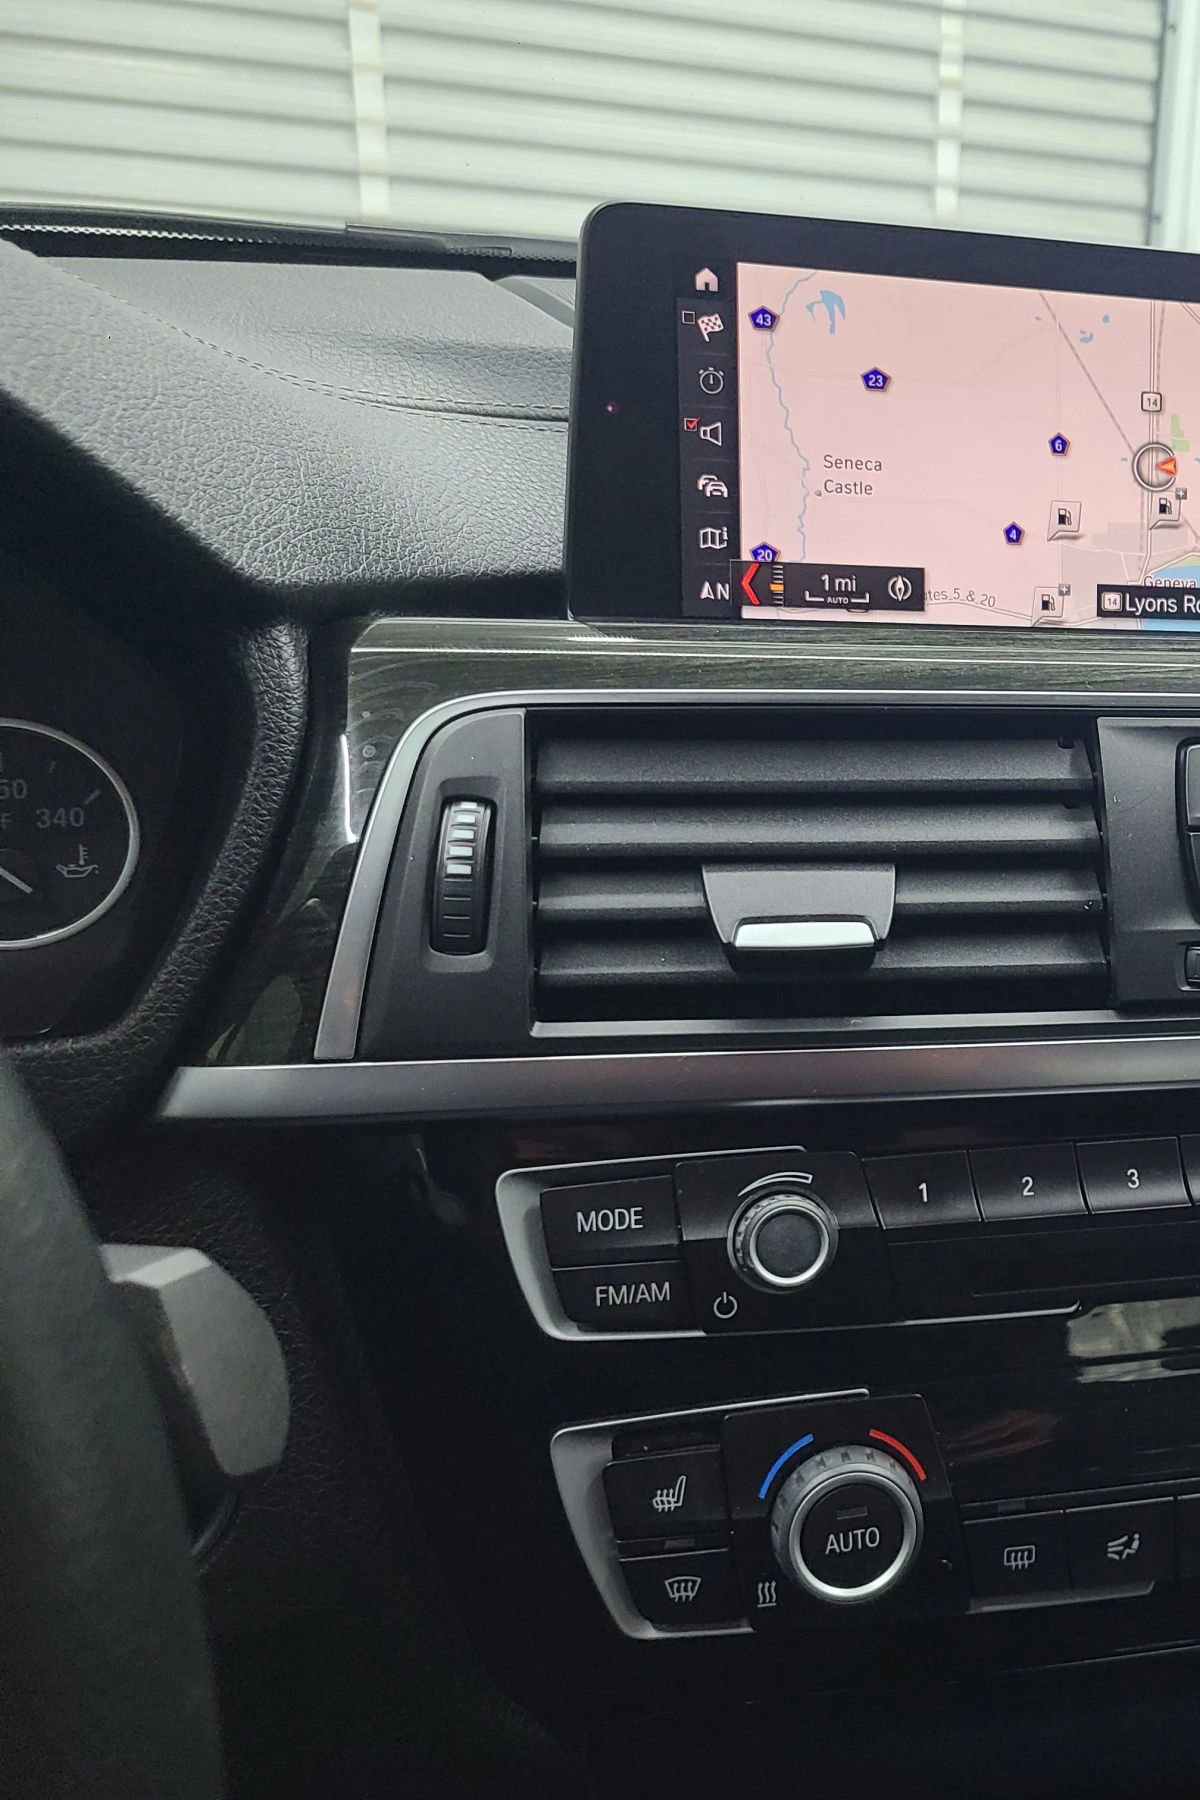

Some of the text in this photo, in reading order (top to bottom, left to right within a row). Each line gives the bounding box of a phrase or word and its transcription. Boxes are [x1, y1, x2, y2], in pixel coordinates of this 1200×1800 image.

[755, 313, 772, 327] 43
[868, 373, 884, 387] 23
[1147, 396, 1158, 408] 14
[1055, 440, 1063, 452] 6
[823, 454, 882, 471] Seneca
[823, 479, 873, 496] Castle
[1009, 529, 1017, 541] 4
[756, 549, 773, 562] 20
[821, 574, 857, 593] 1 mi
[827, 595, 849, 605] AUTO
[980, 593, 996, 608] 20
[1107, 597, 1118, 607] 14
[1125, 593, 1178, 616] Lyons
[36, 807, 85, 829] 340
[1021, 1176, 1034, 1196] 2
[1127, 1168, 1140, 1189] 3
[917, 1182, 929, 1203] 1
[576, 1207, 644, 1234] MODE
[594, 1281, 671, 1307] FM/AM
[825, 1526, 881, 1555] AUTO
